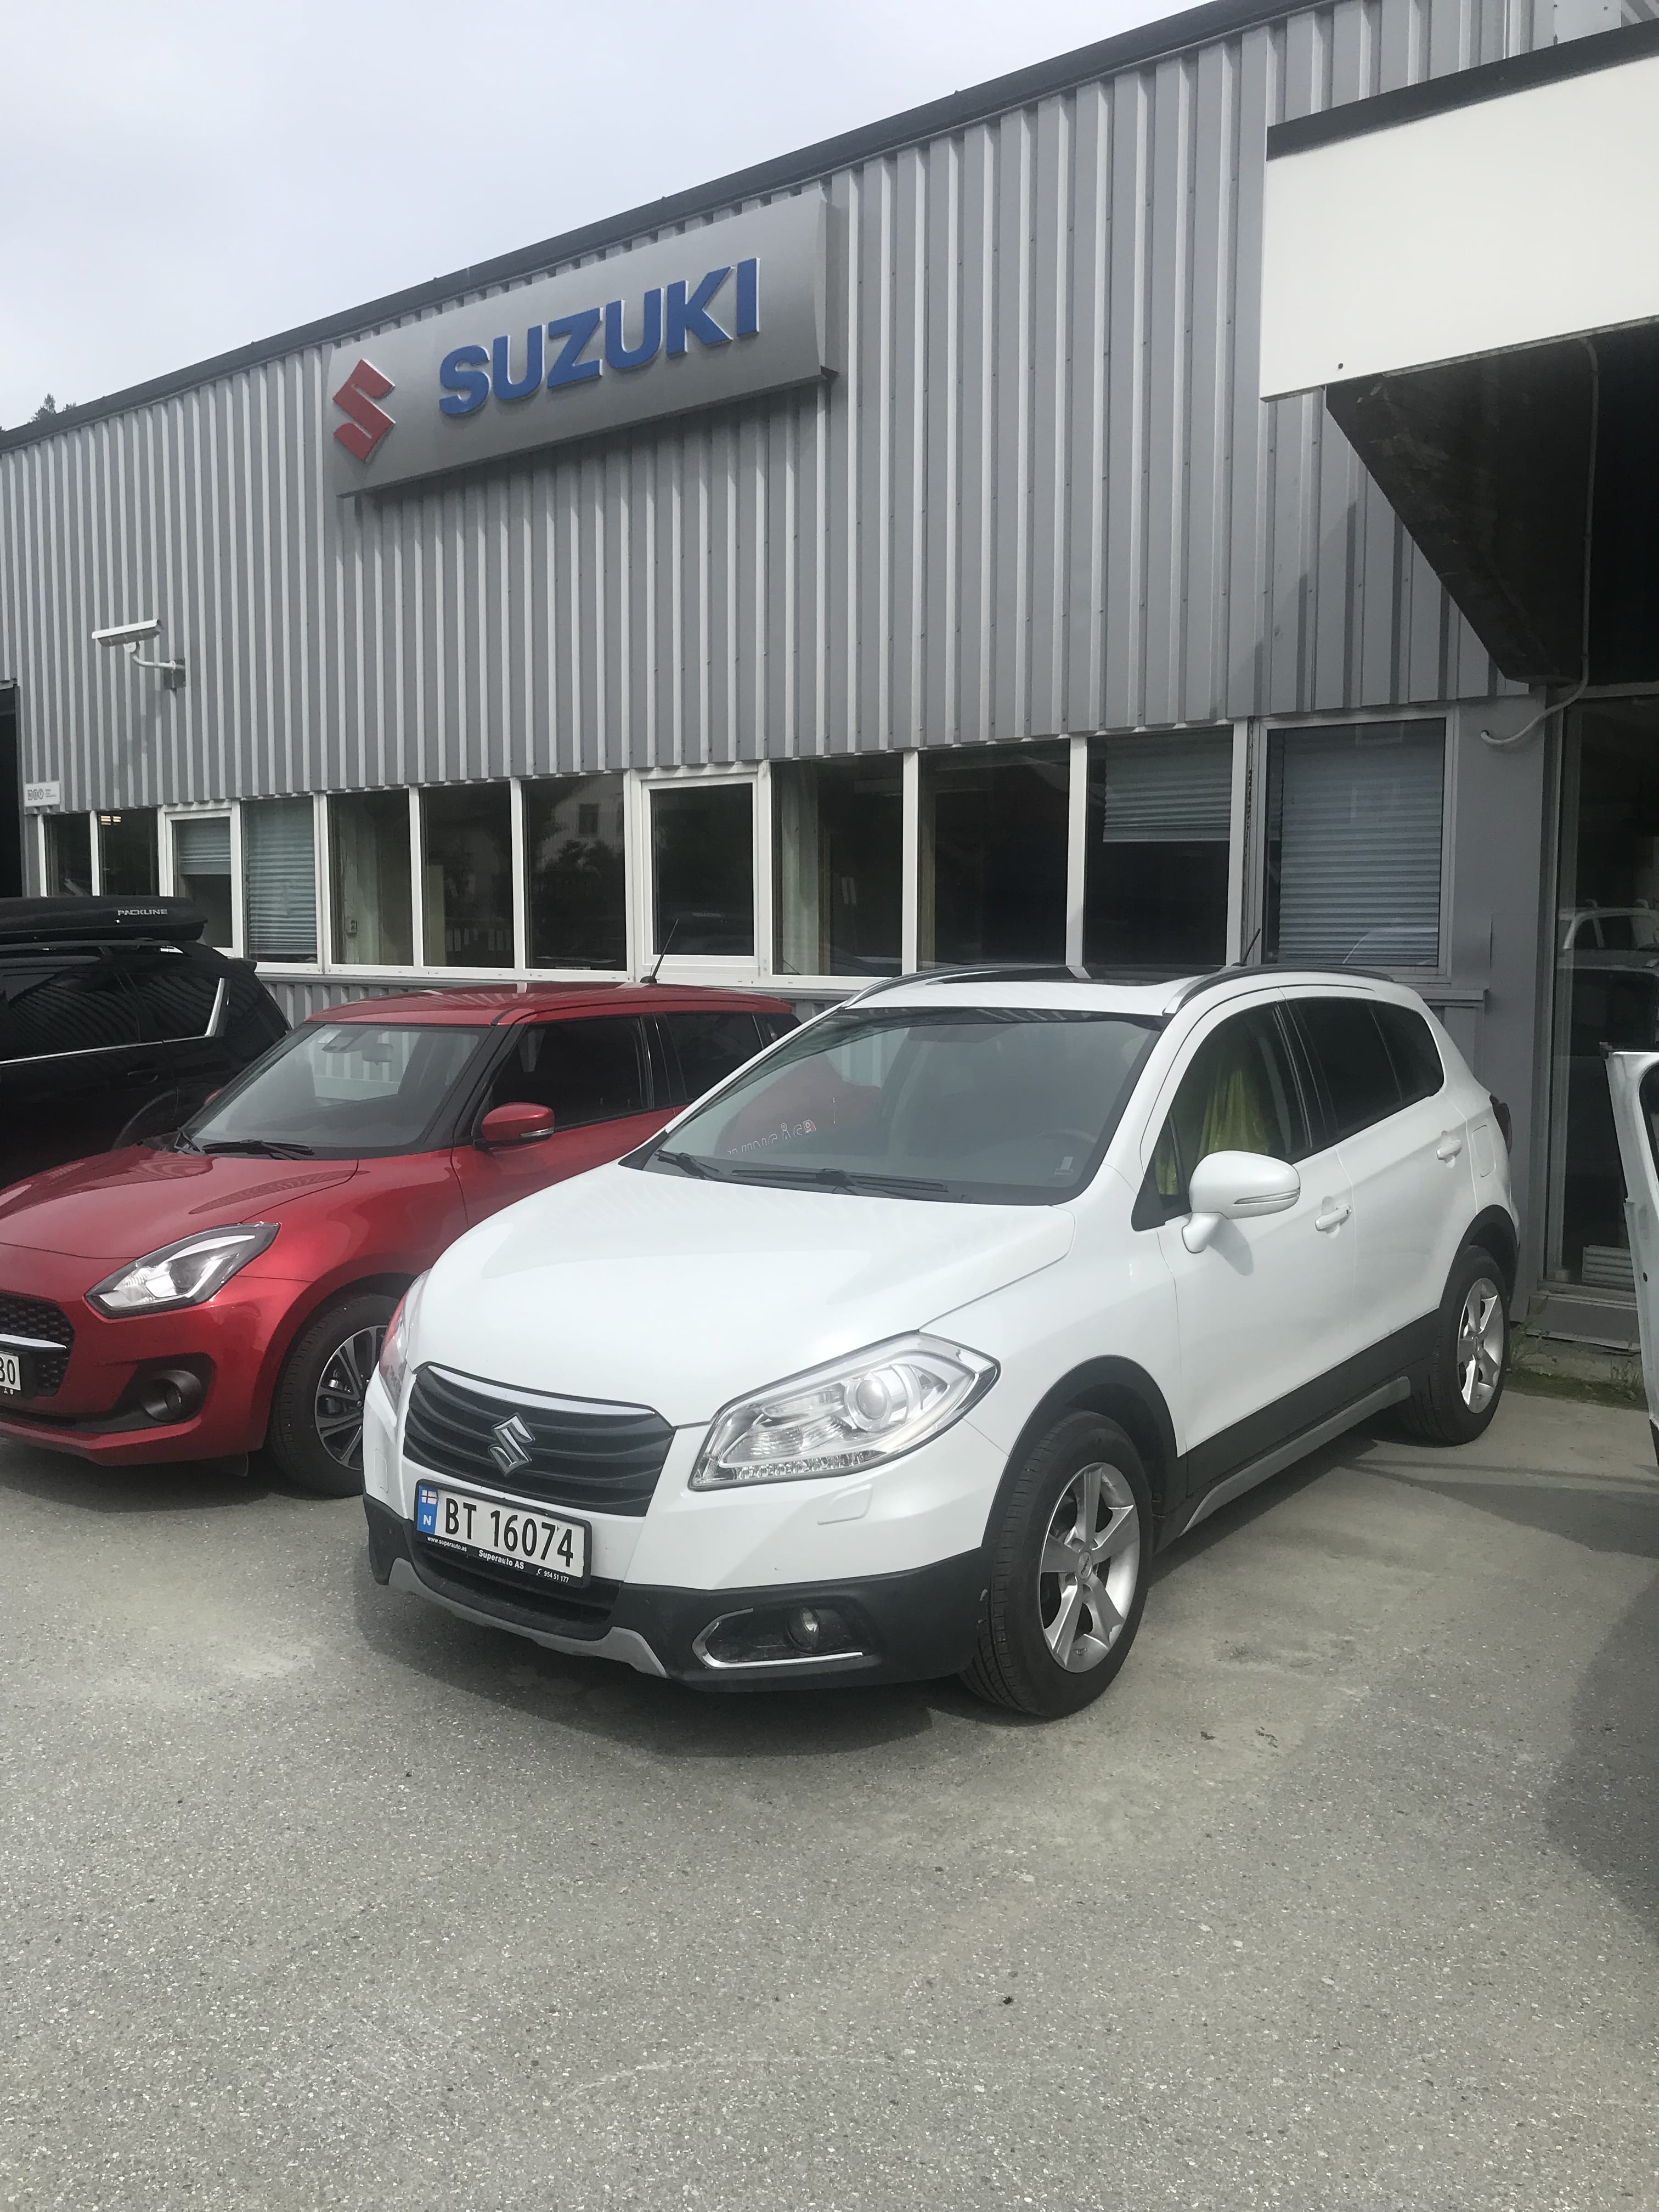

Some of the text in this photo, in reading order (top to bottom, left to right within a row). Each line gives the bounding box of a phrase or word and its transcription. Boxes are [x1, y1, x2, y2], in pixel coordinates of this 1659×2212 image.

[439, 257, 760, 416] SUZUKI
[423, 1515, 432, 1526] N
[445, 1498, 574, 1567] BT 16074
[427, 1537, 467, 1552] www.superauto.as
[478, 1549, 524, 1570] Superauto AS
[544, 1570, 552, 1578] 954
[560, 1575, 569, 1583] 177
